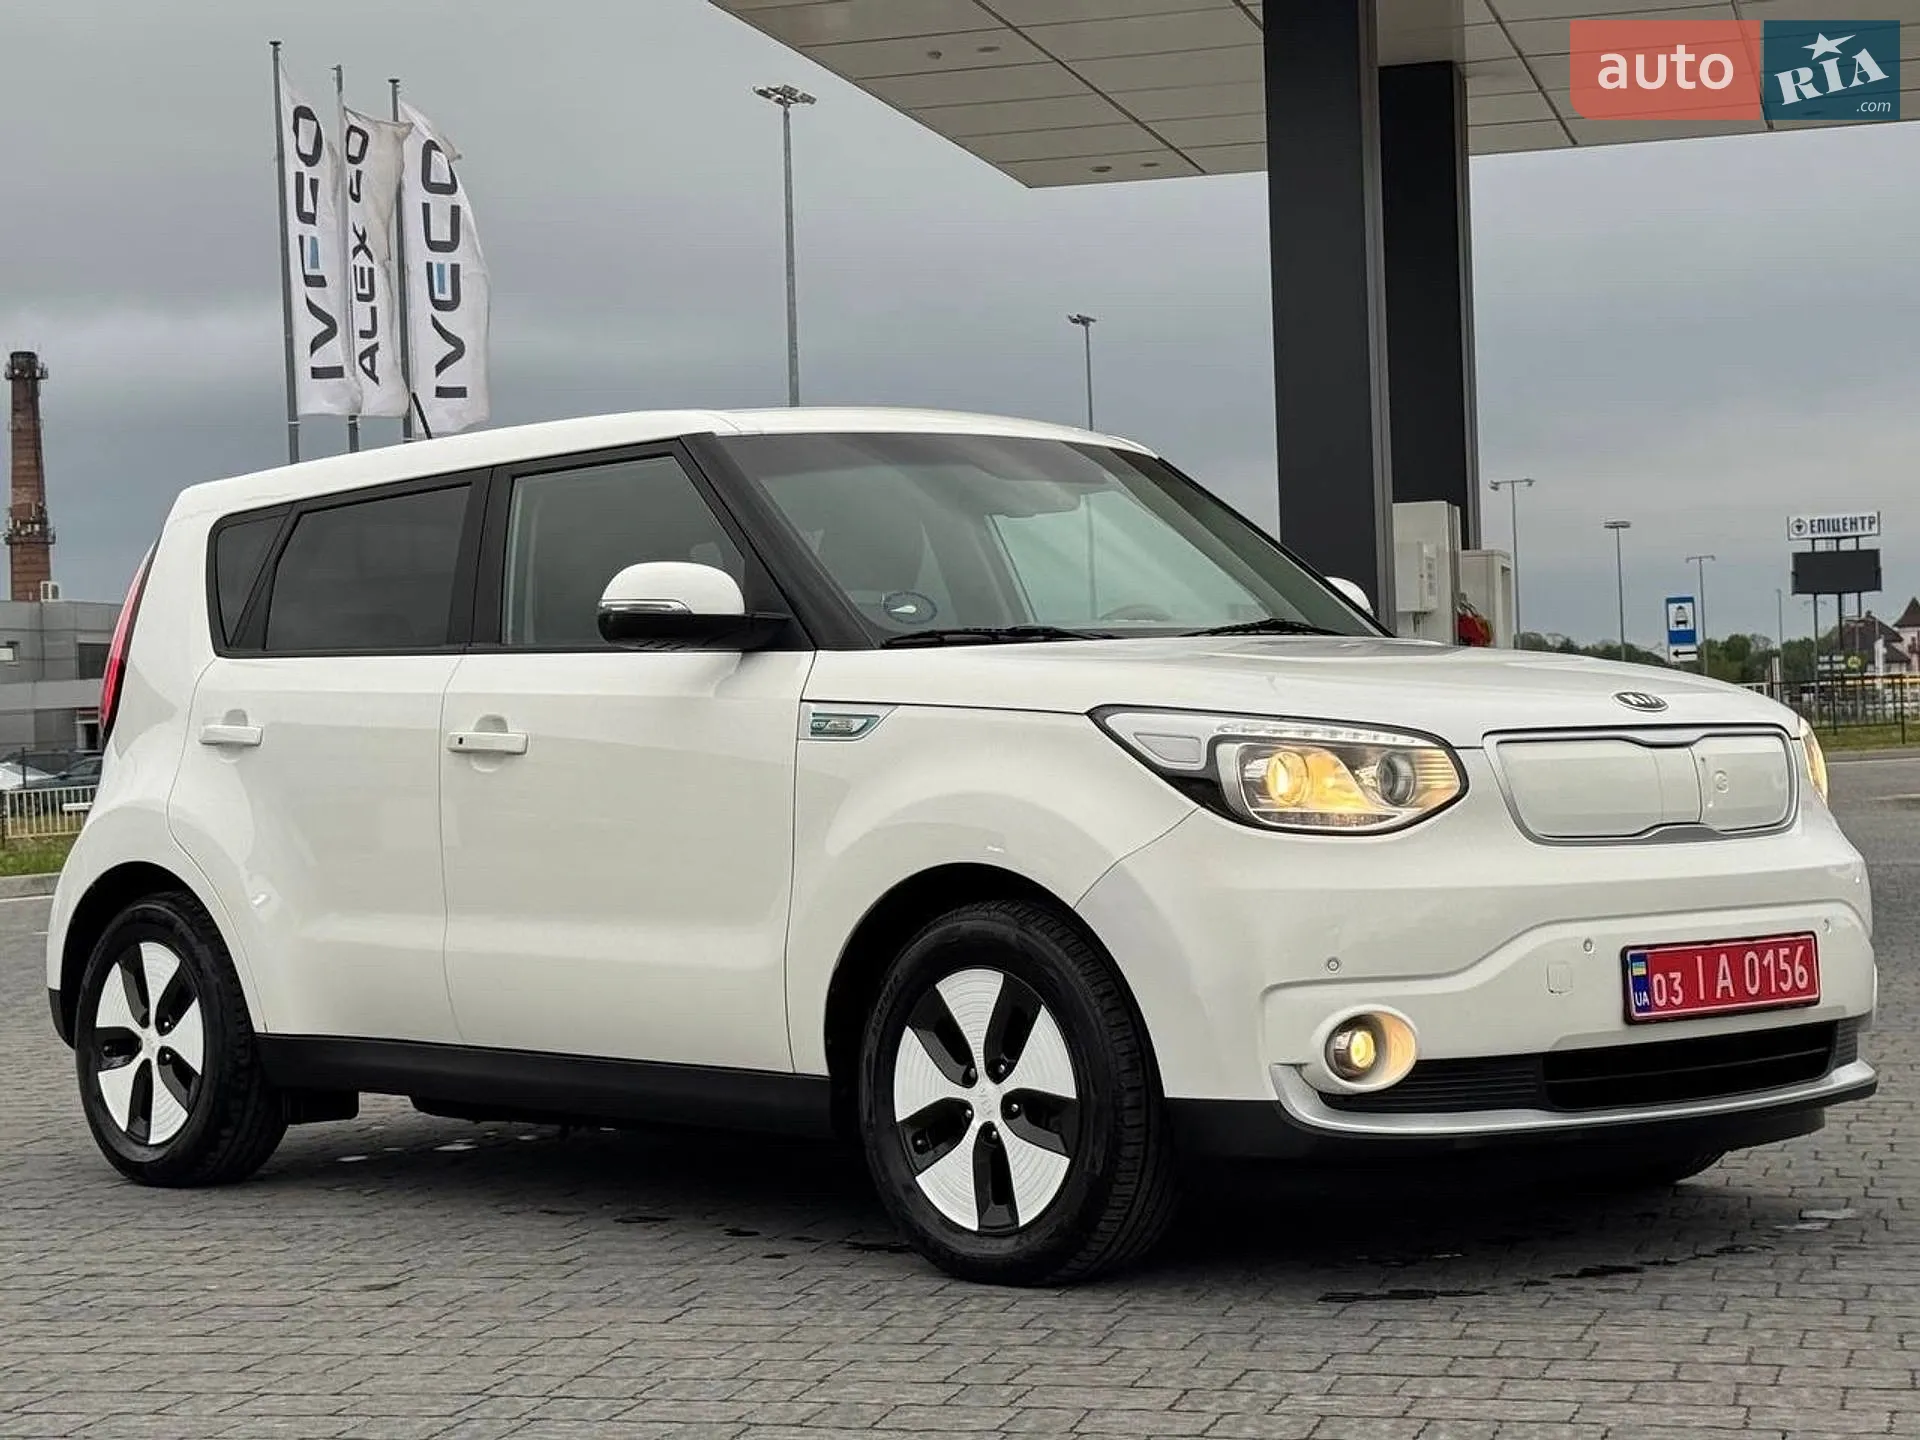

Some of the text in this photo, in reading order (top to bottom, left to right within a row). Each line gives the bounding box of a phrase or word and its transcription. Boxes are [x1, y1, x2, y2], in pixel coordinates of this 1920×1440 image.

[421, 139, 468, 398] IVECO
[352, 224, 380, 385] ALEX
[1810, 516, 1876, 534] ЕПІЦЕНТР
[1634, 991, 1650, 1007] UA
[1652, 971, 1684, 1007] 03
[1744, 945, 1809, 995] 0156
